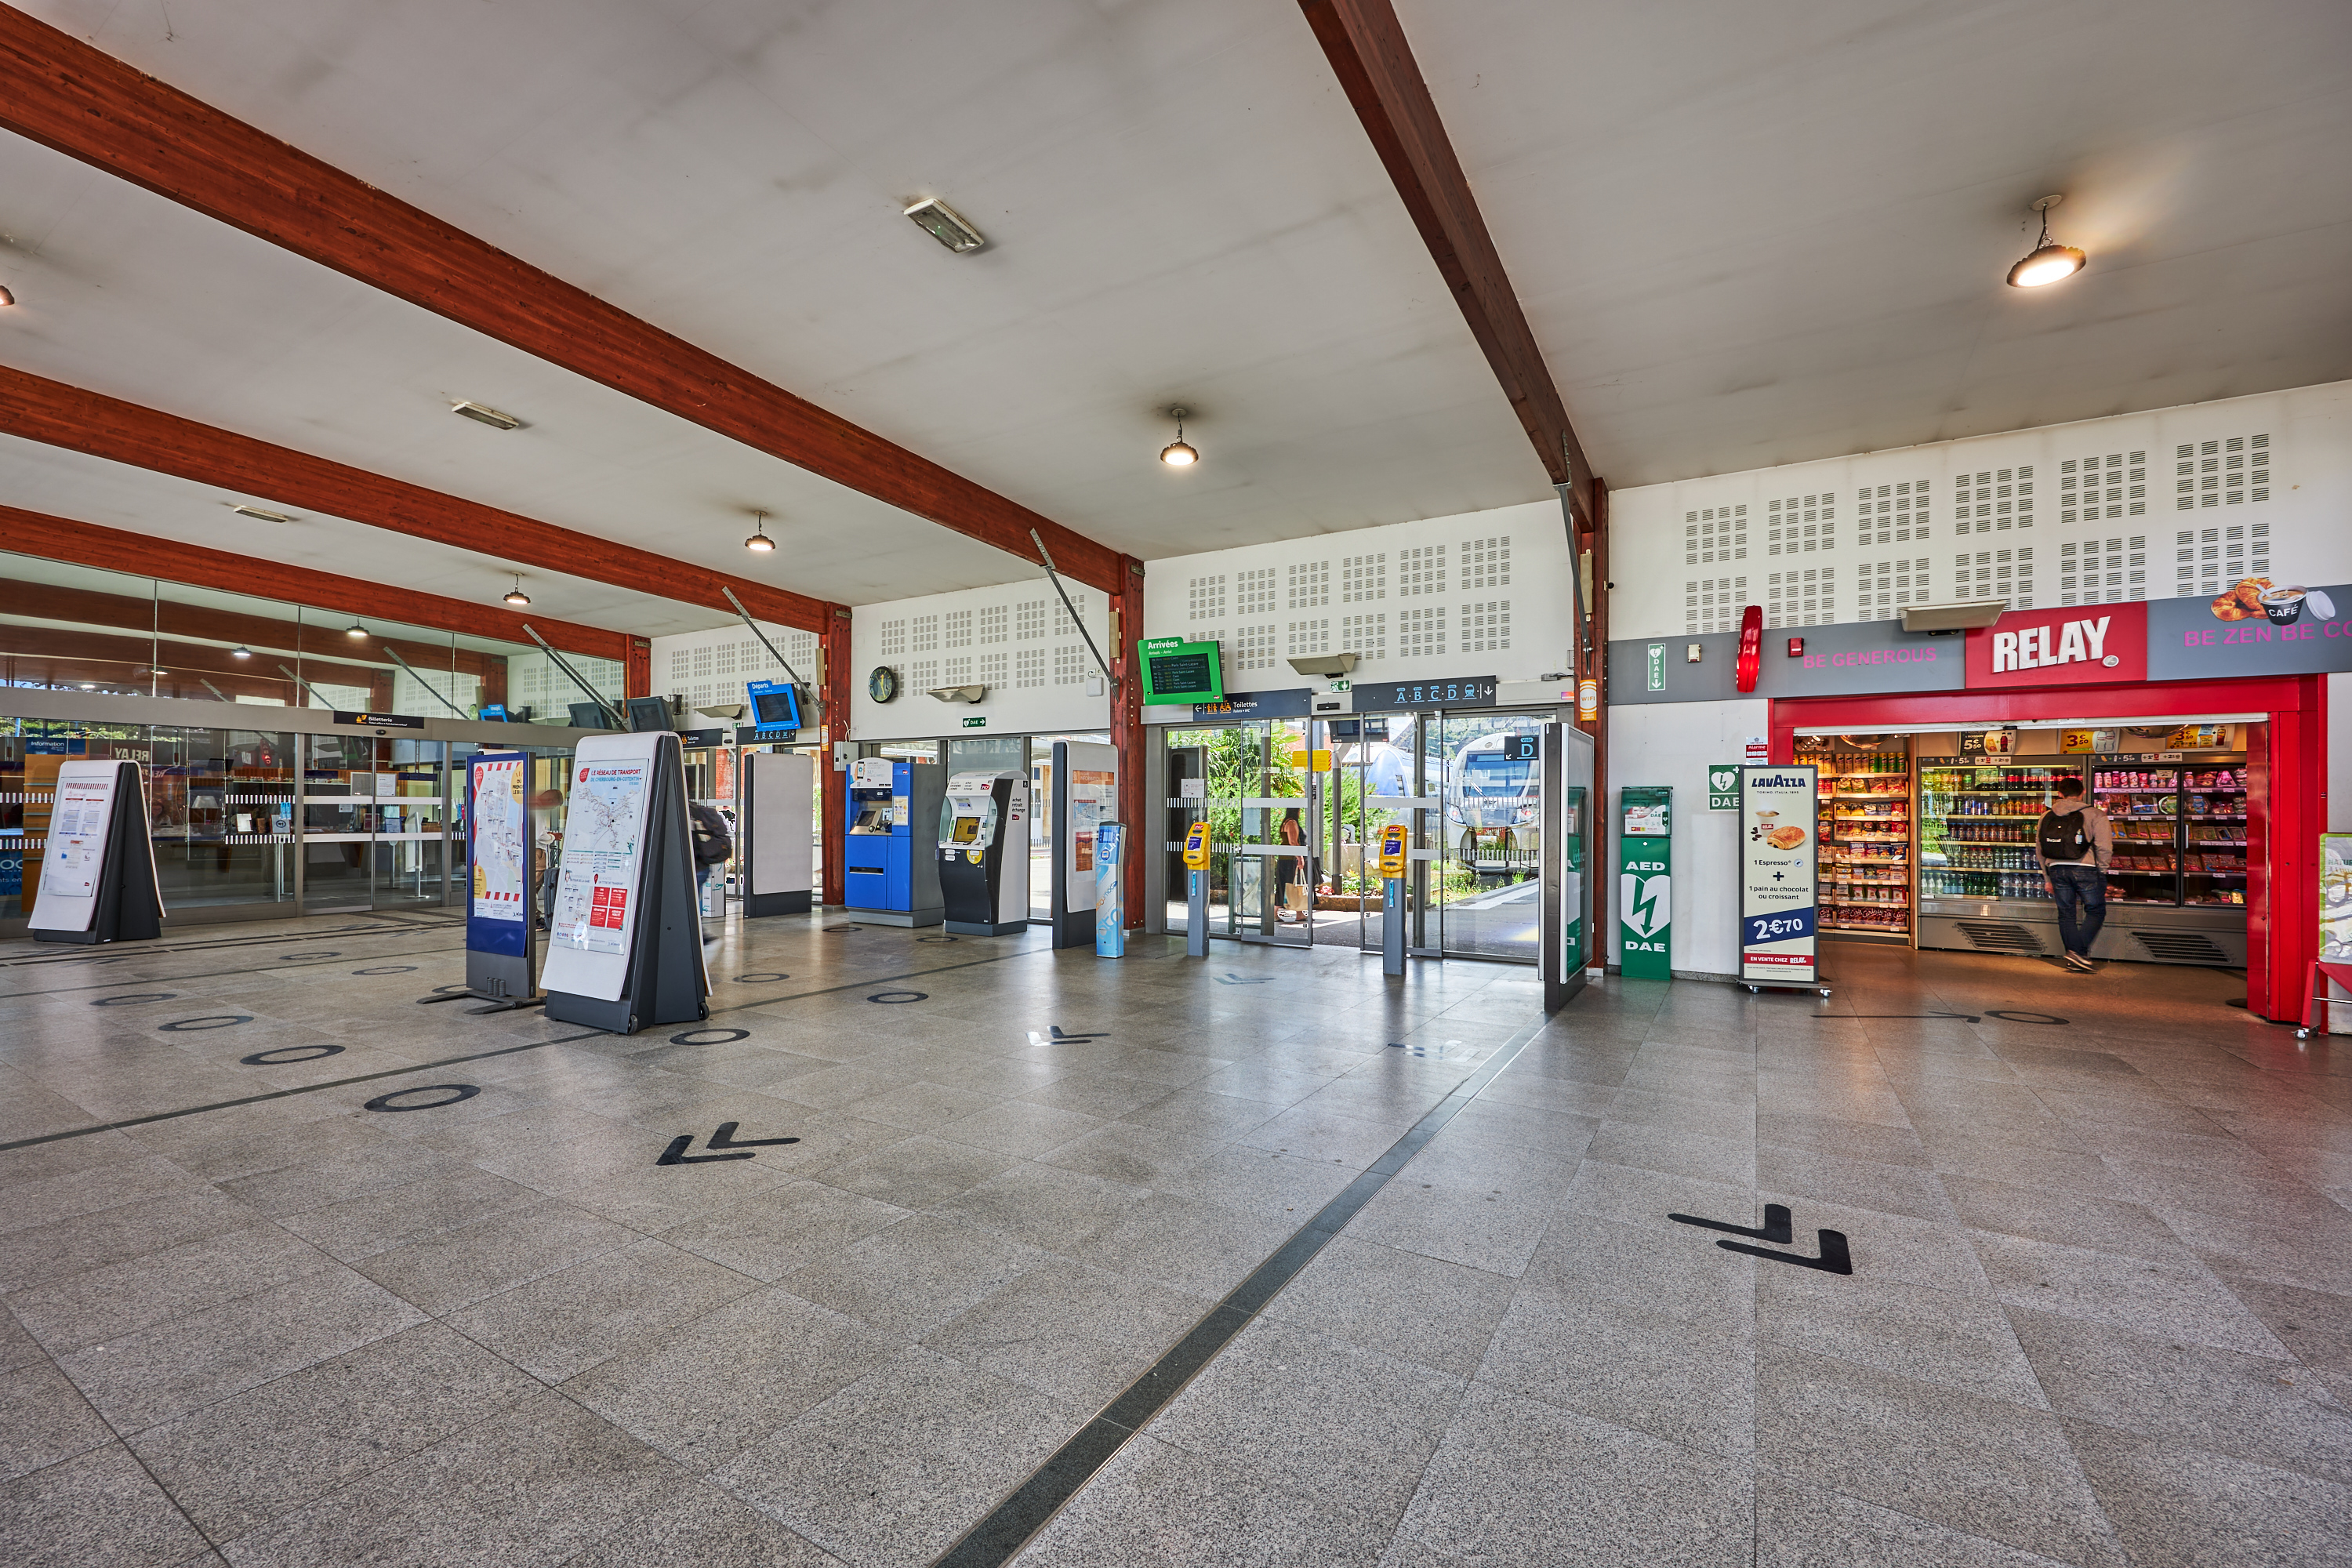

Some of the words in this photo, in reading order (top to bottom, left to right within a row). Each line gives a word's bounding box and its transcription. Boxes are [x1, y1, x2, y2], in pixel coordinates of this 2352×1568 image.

[2268, 604, 2299, 617] CAFÉ
[2184, 630, 2216, 647] BE
[2223, 626, 2271, 644] ZEN
[2281, 623, 2314, 641] BE
[1148, 640, 1178, 649] Arrivées
[1992, 615, 2111, 673] RELAY
[1803, 655, 1826, 668] BE
[1832, 648, 1936, 667] GENEROUS
[1397, 692, 1406, 702] A
[1414, 691, 1422, 701] B
[1431, 691, 1439, 700] C
[1448, 689, 1457, 699] D
[1521, 744, 1534, 757] D
[1751, 775, 1806, 787] LAVAZZA
[1711, 797, 1739, 807] DAE
[1625, 861, 1666, 871] AED
[1753, 918, 1803, 940] 2€70
[1625, 941, 1666, 953] DAE
